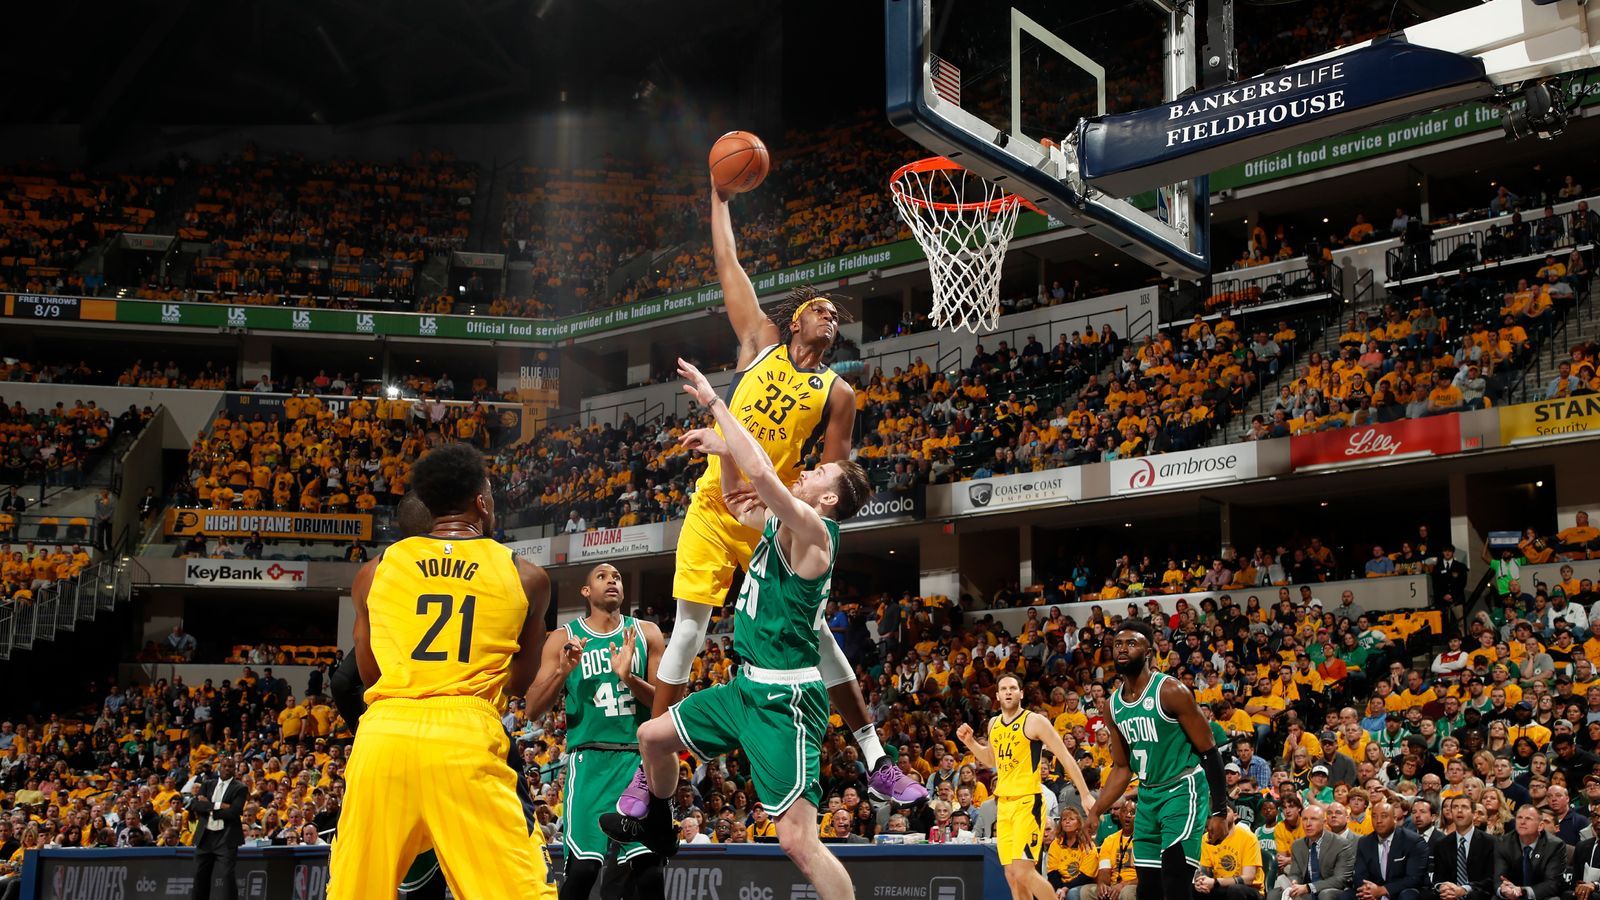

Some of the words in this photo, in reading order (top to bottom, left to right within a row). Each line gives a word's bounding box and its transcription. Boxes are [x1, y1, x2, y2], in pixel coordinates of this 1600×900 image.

[1168, 76, 1293, 121] BANKERS
[1297, 62, 1345, 88] LIFE
[1165, 90, 1345, 147] FIELDHOUSE
[1244, 153, 1292, 178] Official
[1297, 145, 1327, 165] food
[1332, 135, 1383, 158] service
[1387, 119, 1449, 147] provider
[1454, 111, 1470, 128] of
[1475, 105, 1500, 123] the
[18, 295, 39, 304] FREE
[42, 297, 78, 306] THROWS
[466, 321, 505, 334] Official
[509, 324, 532, 336] food
[535, 322, 569, 336] service
[570, 317, 602, 334] provider
[604, 312, 613, 324] of
[615, 309, 629, 322] the
[631, 303, 661, 318] Indiana
[663, 298, 695, 311] Pacers,
[697, 289, 725, 304] Indian
[758, 275, 775, 290] and
[778, 267, 815, 285] Bankers
[818, 261, 836, 276] Life
[839, 250, 891, 271] Fieldhouse
[34, 305, 60, 317] 8/9
[520, 366, 542, 378] BLUE
[542, 367, 560, 379] AND
[520, 377, 542, 390] GOLD
[757, 370, 812, 412] INDIANA
[754, 383, 797, 425] 33
[742, 404, 788, 441] PACERS
[1345, 428, 1401, 455] Lilly
[1159, 454, 1237, 478] ambrose
[994, 483, 1022, 497] COAST
[1033, 478, 1063, 491] COAST
[1001, 490, 1056, 503] IMPORTS
[204, 515, 238, 531] HIGH
[240, 516, 292, 532] OCTANE
[294, 517, 362, 535] DRUMLINE
[583, 528, 622, 547] INDIANA
[187, 565, 263, 582] KeyBank
[415, 557, 480, 581] YOUNG
[1409, 582, 1416, 598] 5
[411, 593, 476, 664] 21
[581, 646, 641, 680] BOSN
[593, 680, 637, 717] 42
[998, 742, 1013, 761] 44
[1132, 749, 1148, 780] 7
[63, 866, 127, 900] PLAYOFFS
[136, 876, 157, 892] abc
[166, 877, 195, 895] ESP
[663, 867, 722, 900] YOFFS
[739, 881, 774, 900] abc
[874, 886, 927, 897] STREAMING
